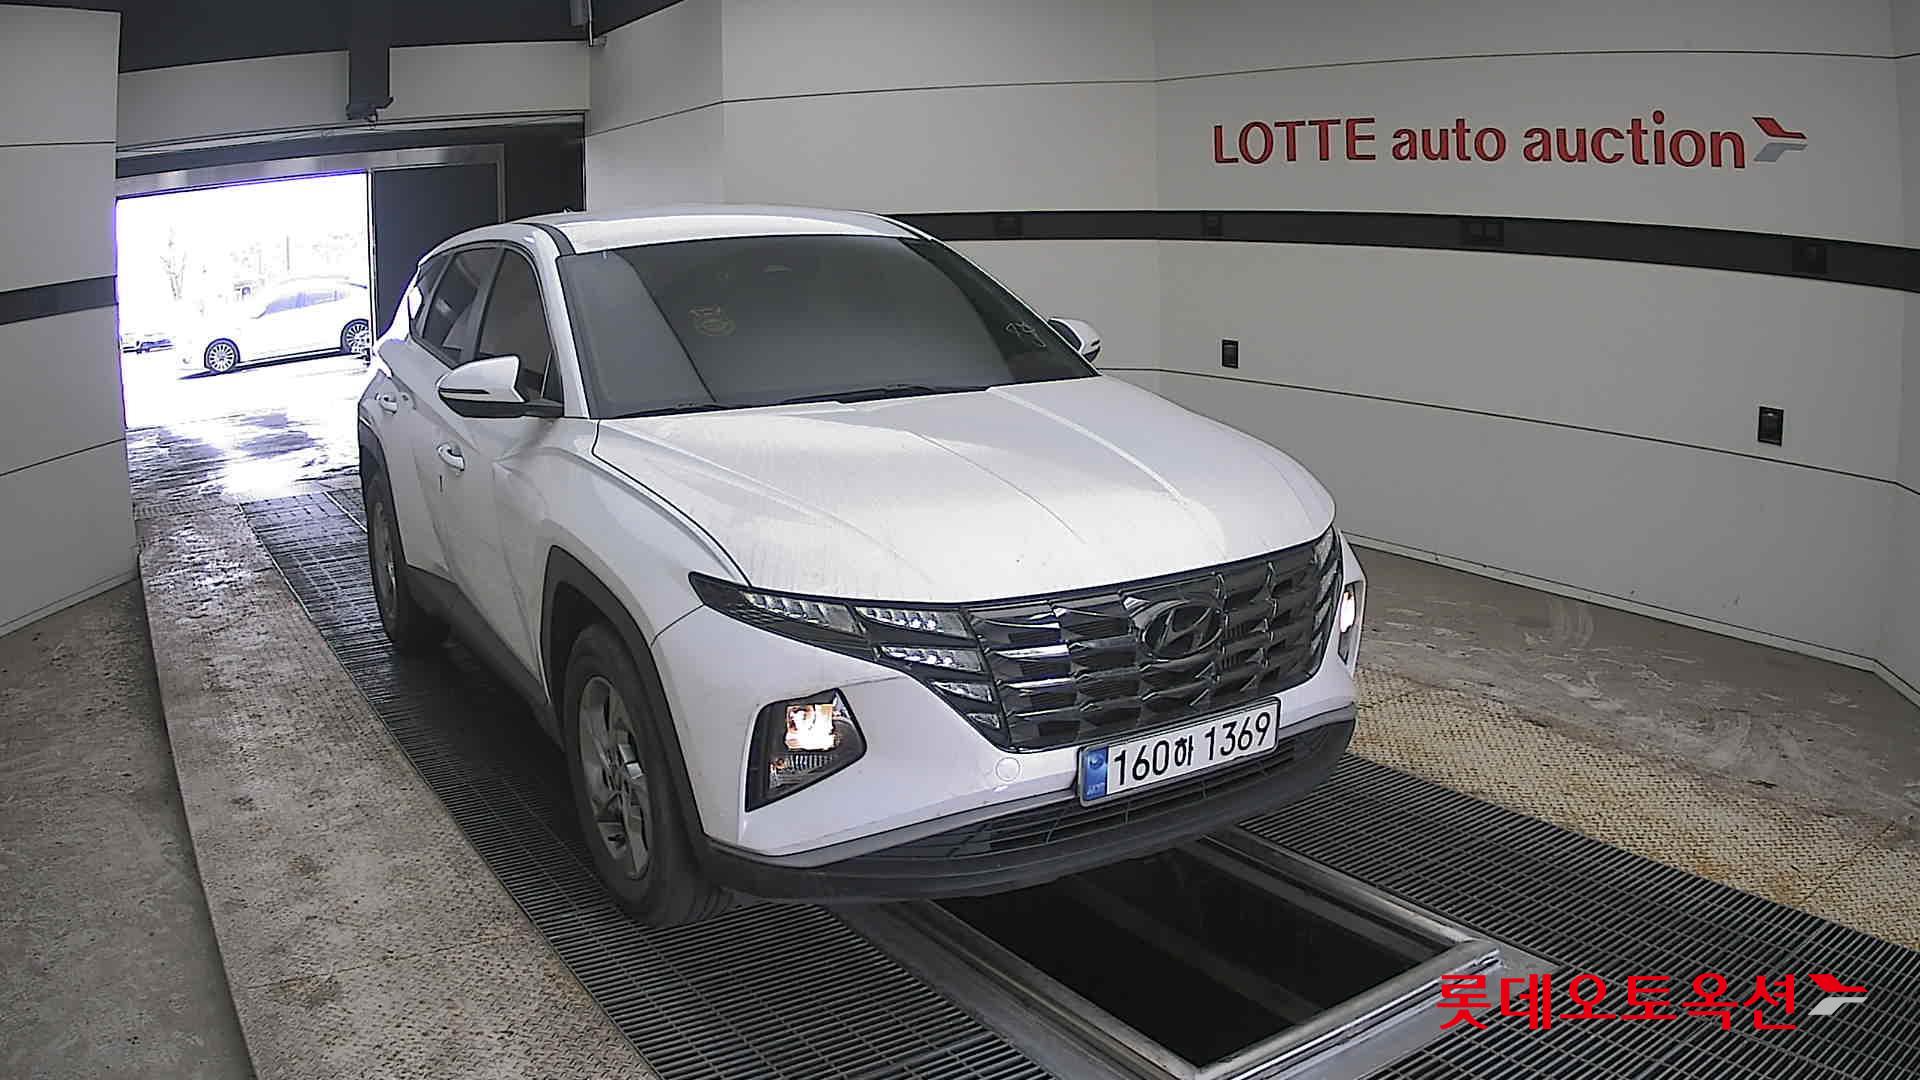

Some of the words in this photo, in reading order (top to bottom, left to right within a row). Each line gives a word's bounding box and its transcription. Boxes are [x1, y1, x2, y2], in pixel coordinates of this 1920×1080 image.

[1213, 116, 1376, 164] LOTTE
[1392, 118, 1507, 162] auto
[1522, 110, 1746, 169] auction
[1114, 735, 1194, 786] 160하
[1204, 711, 1271, 761] 1369
